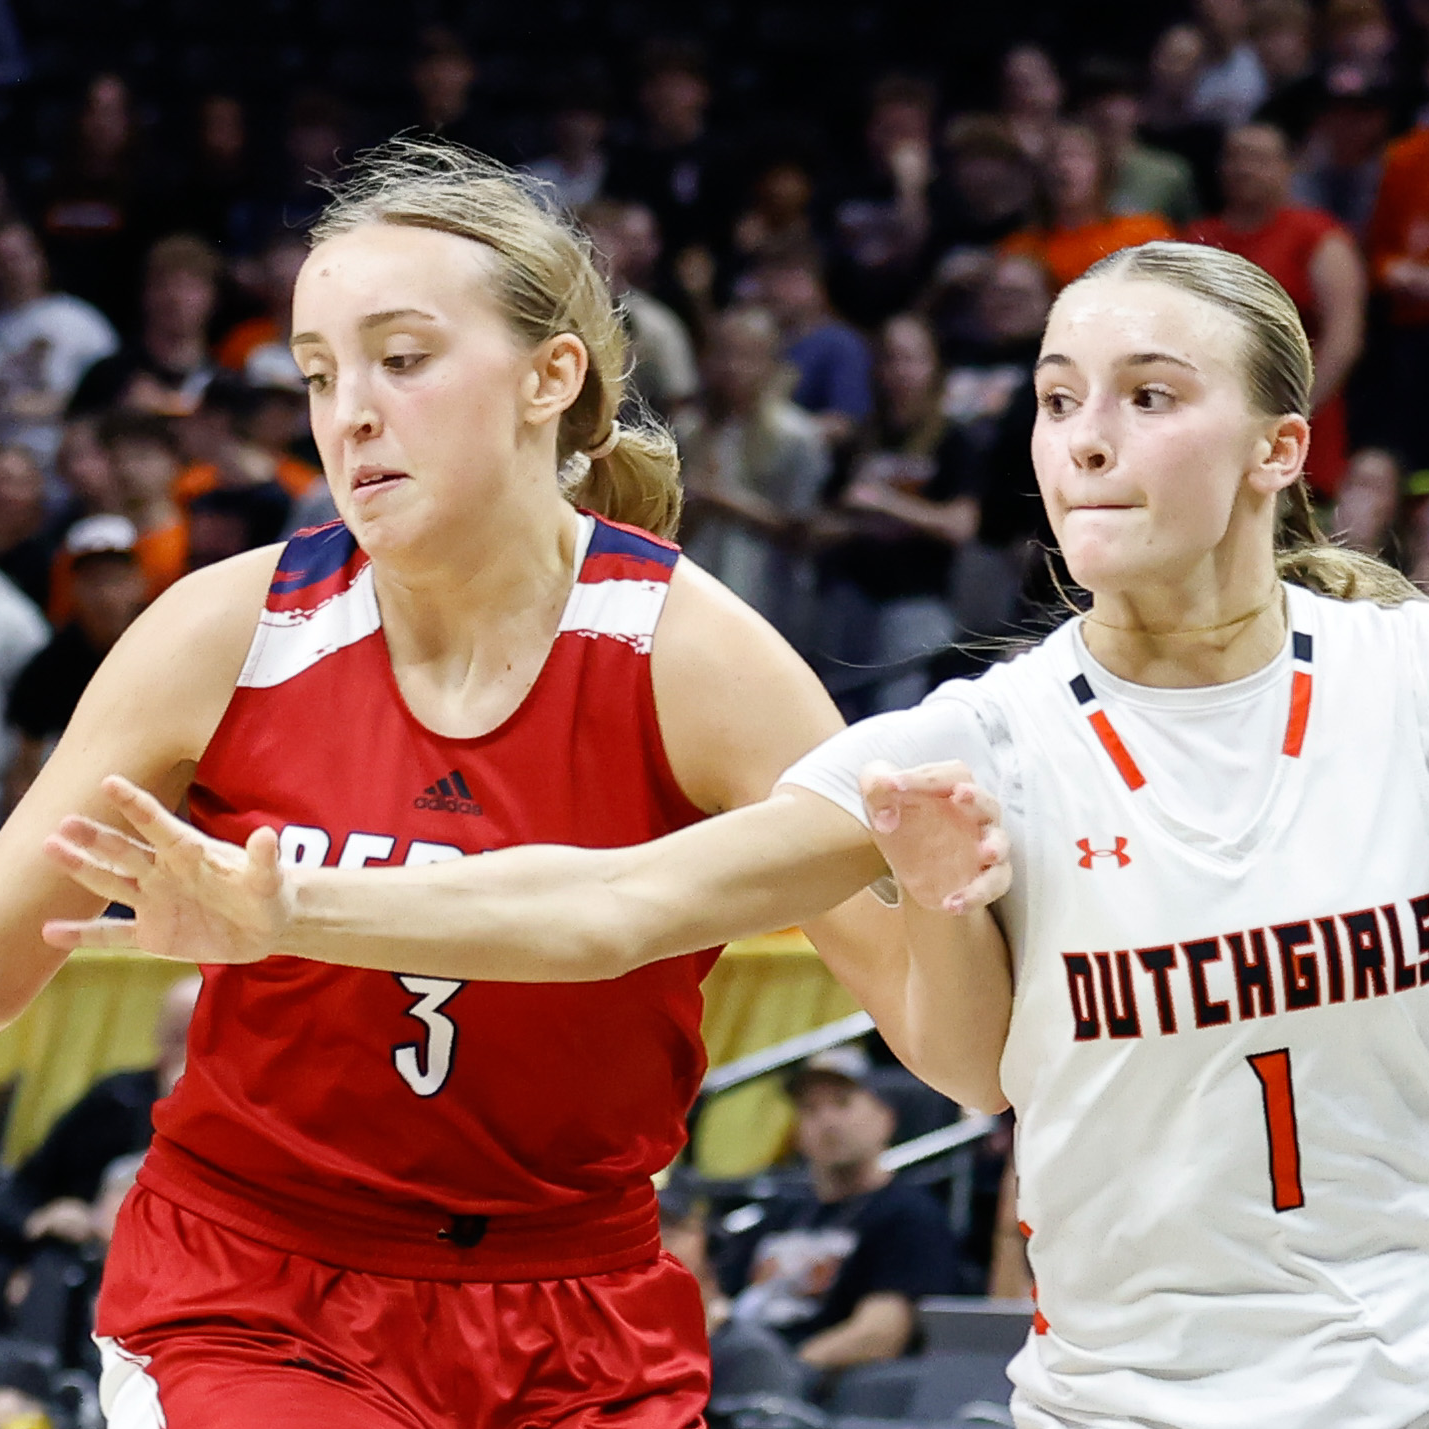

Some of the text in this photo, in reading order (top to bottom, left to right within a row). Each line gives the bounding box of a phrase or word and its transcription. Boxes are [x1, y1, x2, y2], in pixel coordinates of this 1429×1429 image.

[414, 796, 483, 816] adidas
[392, 971, 466, 1098] 3
[1245, 1047, 1305, 1213] 1
